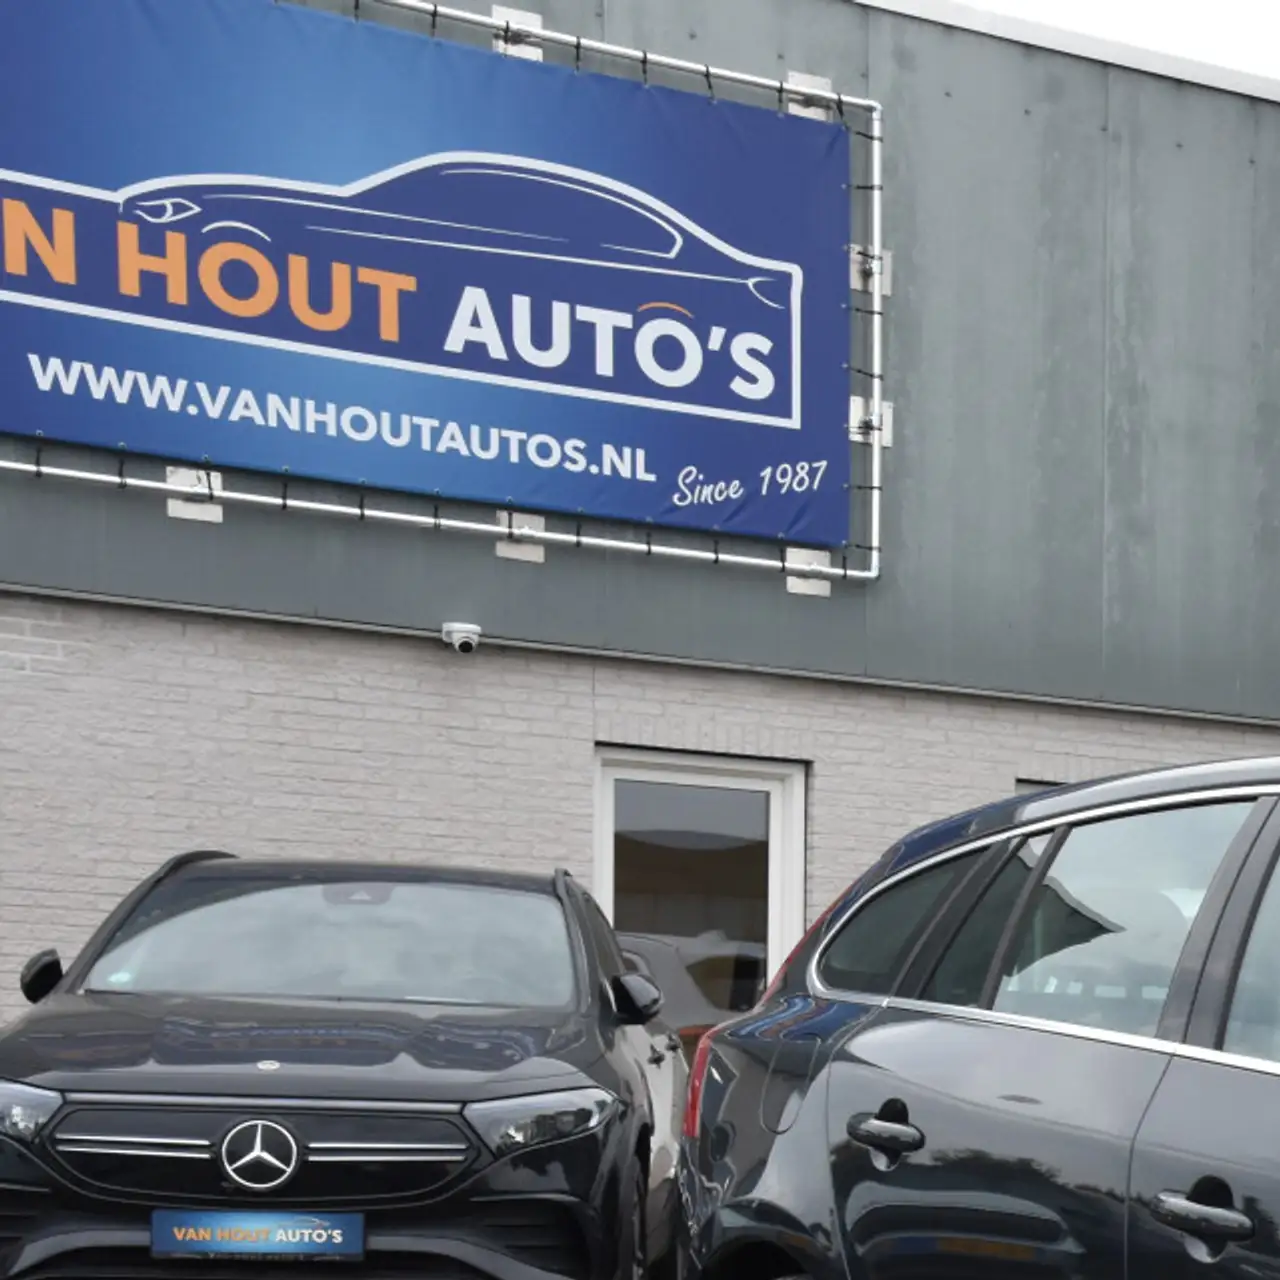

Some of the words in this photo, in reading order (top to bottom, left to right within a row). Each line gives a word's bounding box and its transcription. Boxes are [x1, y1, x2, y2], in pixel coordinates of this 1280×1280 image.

[117, 220, 417, 342] HOUT
[443, 285, 776, 401] AUTO'S
[27, 352, 658, 482] WWW.VANHOUTAUTOS.NL
[672, 465, 745, 507] Since
[759, 460, 829, 496] 1987
[173, 1226, 212, 1241] VAN
[216, 1227, 270, 1243] HOUT
[275, 1229, 344, 1244] AUTO'S
